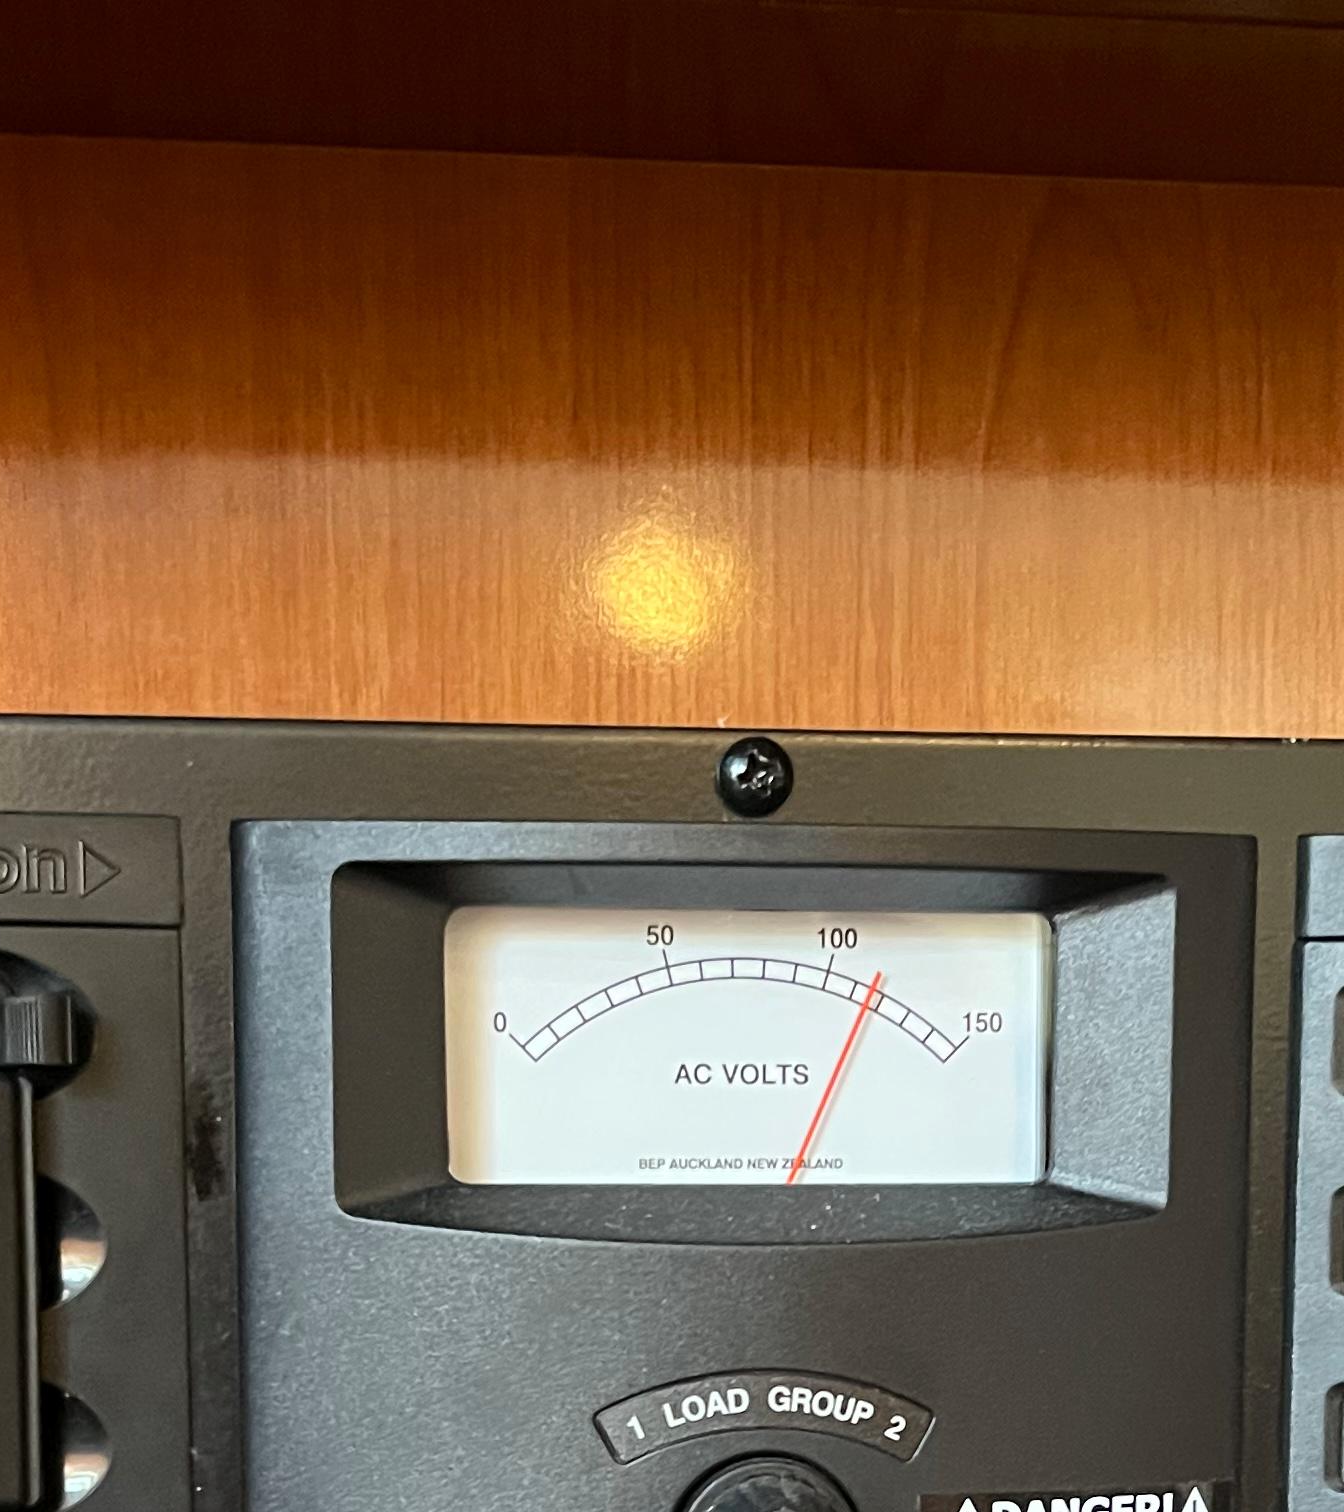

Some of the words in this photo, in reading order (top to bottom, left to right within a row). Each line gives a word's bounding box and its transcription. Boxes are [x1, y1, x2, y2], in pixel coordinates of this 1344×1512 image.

[646, 924, 674, 946] 50
[817, 927, 858, 949] 100
[493, 1011, 507, 1033] 0
[962, 1012, 1003, 1033] 150
[674, 1063, 712, 1085] AC
[721, 1063, 809, 1085] VOLTS
[638, 1157, 666, 1170] BEP
[668, 1157, 744, 1170] AUCKLAND
[746, 1157, 778, 1170] NEW
[626, 1415, 646, 1440] 1
[662, 1388, 750, 1428] LOAD
[767, 1385, 875, 1425] GROUP
[884, 1415, 907, 1440] 2
